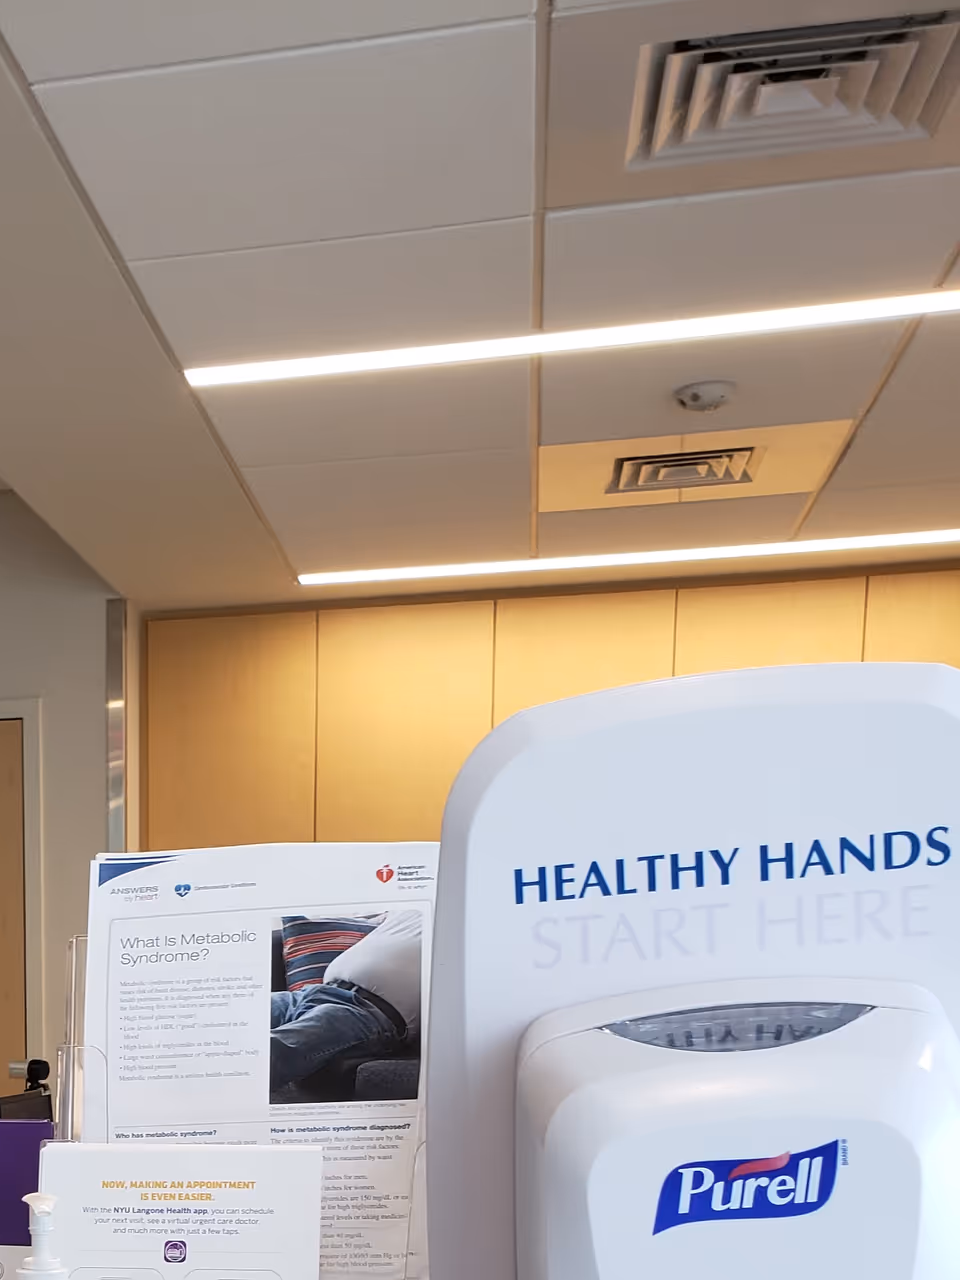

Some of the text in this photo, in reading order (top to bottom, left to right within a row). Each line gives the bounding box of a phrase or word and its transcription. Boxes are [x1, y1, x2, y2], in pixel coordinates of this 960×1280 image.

[514, 826, 951, 904] HEALTHY HANDS
[110, 886, 159, 895] ANSWERS
[134, 893, 159, 902] heart
[530, 884, 933, 970] START HERE
[120, 929, 257, 949] What Is Metabolic
[120, 948, 210, 967] Syndrome?
[296, 1125, 330, 1133] metabolic
[332, 1124, 368, 1133] syndrome
[369, 1123, 411, 1131] diagnosed?
[180, 1129, 217, 1138] syndrome?
[101, 1180, 256, 1190] NOW, MAKING AN APPOINTMENT
[678, 1156, 824, 1214] Purell
[141, 1193, 216, 1201] IS EVEN EASIER.
[132, 1207, 164, 1215] Langone
